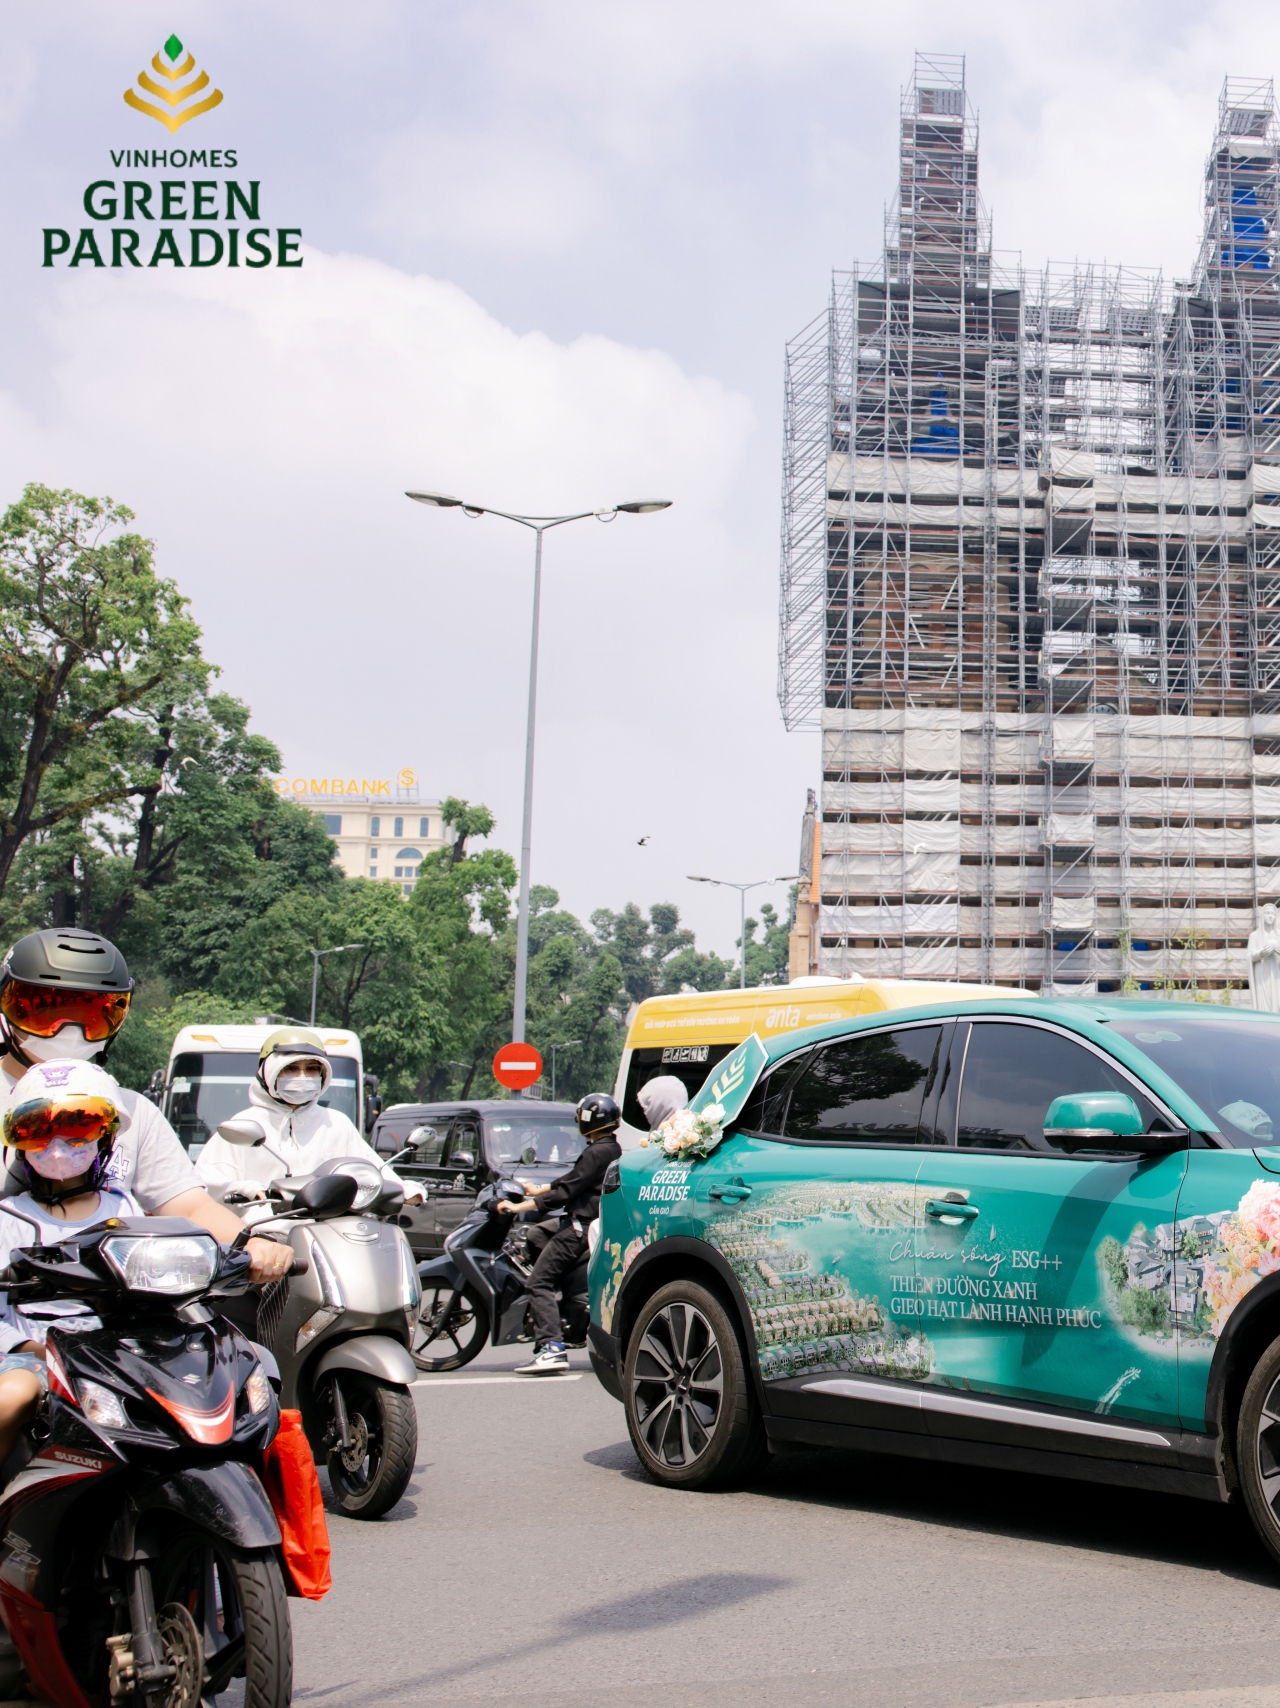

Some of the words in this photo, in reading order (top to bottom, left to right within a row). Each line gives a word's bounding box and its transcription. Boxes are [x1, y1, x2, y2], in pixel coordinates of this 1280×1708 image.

[273, 777, 392, 796] COMBANK
[765, 1004, 800, 1029] anta
[651, 1170, 691, 1184] GREEN
[638, 1186, 691, 1201] PARADISE
[1011, 1249, 1063, 1271] ESG++
[890, 1272, 936, 1294] THIÊN
[936, 1275, 990, 1297] ĐƯỜNG
[992, 1280, 1038, 1300] XANH
[890, 1297, 925, 1316] GIEO
[927, 1300, 958, 1321] HẠT
[960, 1298, 1002, 1322] LÀNH
[1005, 1304, 1054, 1327] HẠNH
[1056, 1305, 1102, 1329] PHÚC
[54, 1451, 102, 1469] SUZUKI
